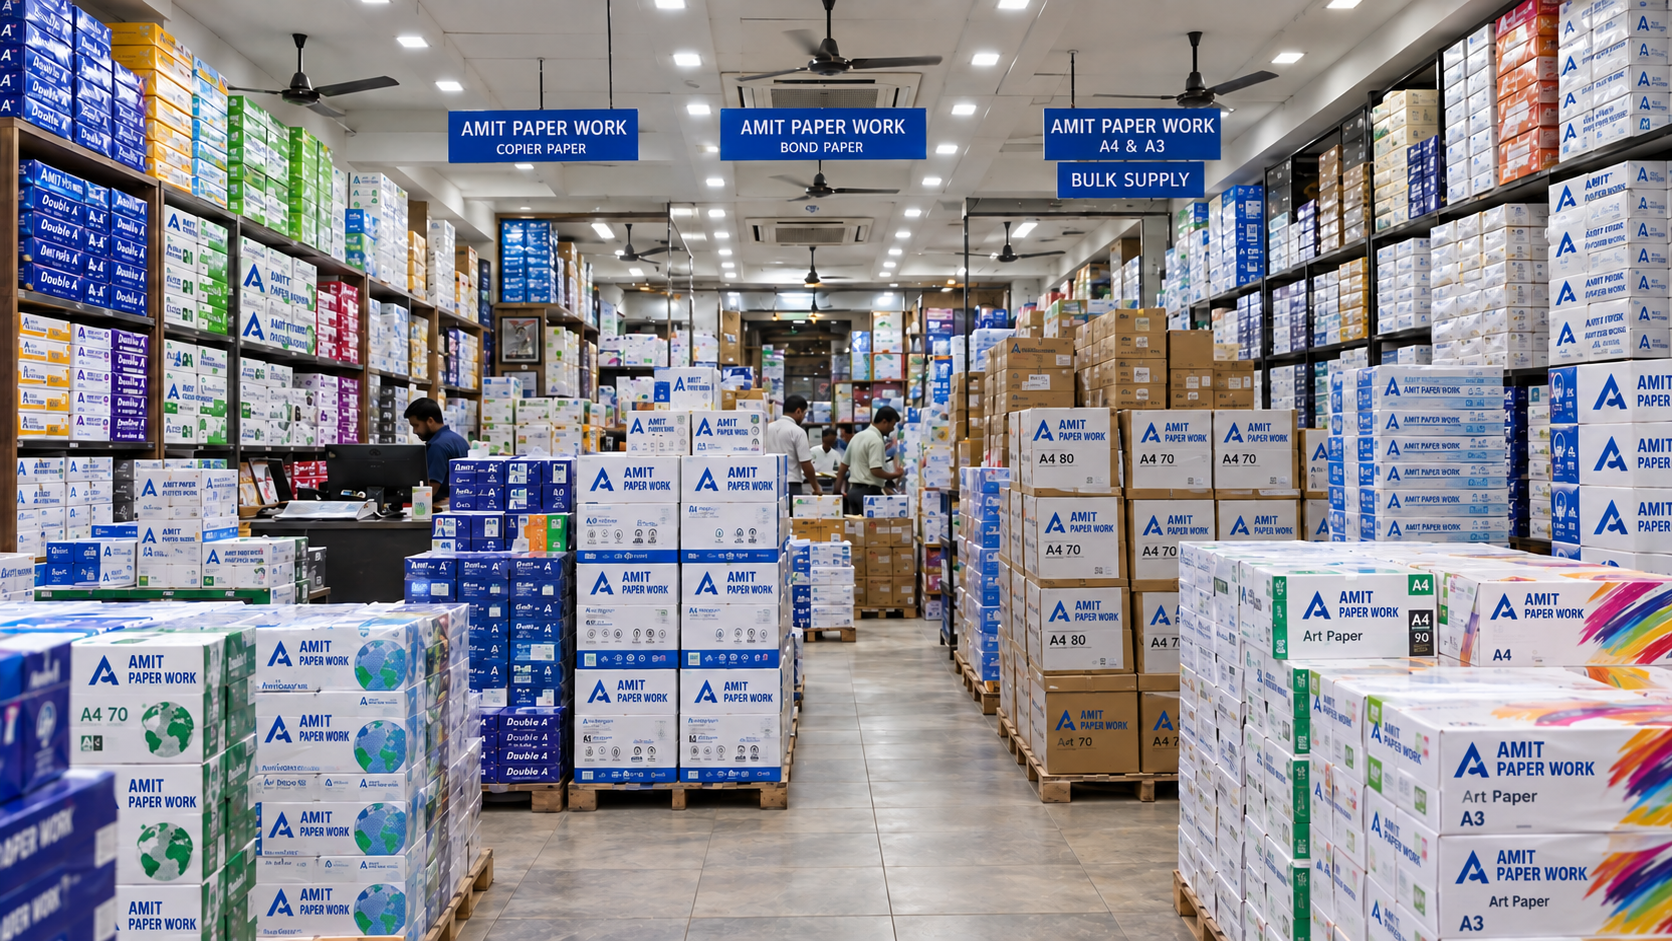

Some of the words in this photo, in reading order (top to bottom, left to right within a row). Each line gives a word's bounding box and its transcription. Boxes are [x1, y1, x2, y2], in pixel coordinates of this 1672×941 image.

[461, 120, 506, 137] AMIT
[513, 120, 568, 136] PAPER
[574, 120, 627, 136] WORK
[740, 119, 785, 135] AMIT
[791, 119, 846, 135] PAPER
[852, 118, 906, 135] WORK
[1050, 118, 1096, 134] AMIT
[1101, 118, 1156, 134] PAPER
[1162, 117, 1215, 134] WORK
[496, 144, 542, 155] COPIER
[547, 143, 586, 154] PAPER
[780, 142, 818, 153] BOND
[823, 141, 863, 153] PAPER
[1099, 140, 1119, 153] A4
[1125, 139, 1137, 153] &
[1145, 139, 1165, 153] A3
[1071, 172, 1117, 188] BULK
[1124, 172, 1190, 188] SUPPLY
[41, 218, 71, 238] Double
[41, 271, 70, 288] Double
[1637, 394, 1671, 408] PAPER
[1058, 419, 1086, 430] AMIT
[1164, 422, 1189, 432] AMIT
[1247, 423, 1272, 432] AMIT
[1058, 431, 1083, 441] PAPER
[1083, 431, 1106, 441] WORK
[1164, 434, 1186, 443] PAPER
[1187, 434, 1207, 443] WORK
[1247, 434, 1268, 443] PAPER
[1269, 434, 1288, 443] WORK
[1039, 453, 1056, 464] A4
[1059, 453, 1075, 464] 80
[1139, 453, 1157, 465] A4
[1160, 453, 1175, 465] 70
[1222, 453, 1239, 465] A4
[1242, 453, 1257, 465] 70
[1637, 456, 1671, 469] PAPER
[624, 466, 655, 479] AMIT
[727, 466, 758, 479] AMIT
[623, 480, 648, 491] PAPER
[648, 480, 671, 491] WORK
[727, 480, 750, 491] PAPER
[751, 480, 774, 491] WORK
[1070, 511, 1098, 523] AMIT
[1167, 514, 1194, 525] AMIT
[1254, 515, 1278, 525] AMIT
[1070, 524, 1092, 533] PAPER
[1093, 524, 1114, 533] WORK
[1638, 520, 1672, 532] PAPER
[1045, 544, 1063, 555] A4
[1066, 544, 1081, 555] 70
[1142, 546, 1159, 557] A4
[1162, 546, 1177, 557] 70
[622, 571, 651, 583] AMIT
[727, 571, 757, 583] AMIT
[622, 585, 645, 594] PAPER
[646, 585, 669, 594] WORK
[727, 585, 750, 595] PAPER
[750, 585, 773, 595] WORK
[1412, 579, 1430, 591] A4
[1339, 590, 1374, 604] AMIT
[1524, 592, 1560, 606] AMIT
[1075, 600, 1102, 611] AMIT
[1075, 612, 1097, 622] PAPER
[1097, 612, 1119, 622] WORK
[1339, 606, 1369, 618] PAPER
[1370, 606, 1399, 618] WORK
[1524, 608, 1554, 619] PAPER
[1555, 608, 1585, 619] WORK
[1411, 613, 1430, 626] A4
[1049, 634, 1067, 646] A4
[1071, 634, 1086, 646] 80
[1151, 637, 1167, 648] A4
[1302, 630, 1323, 642] Art
[1326, 630, 1363, 644] Paper
[1414, 632, 1429, 643] 90
[299, 640, 332, 653] AMIT
[1492, 648, 1512, 661] A4
[128, 654, 164, 669] AMIT
[299, 656, 324, 666] PAPER
[325, 656, 350, 666] WORK
[128, 672, 162, 684] PAPER
[164, 672, 197, 684] WORK
[617, 679, 646, 691] AMIT
[724, 681, 749, 691] AMIT
[617, 693, 642, 703] PAPER
[643, 693, 668, 703] WORK
[724, 693, 748, 703] PAPER
[749, 693, 773, 703] WORK
[80, 706, 103, 722] A4
[108, 706, 128, 722] 70
[1080, 710, 1104, 720] AMIT
[299, 714, 332, 728] AMIT
[506, 717, 539, 727] Double
[541, 718, 548, 727] A
[1080, 721, 1104, 730] PAPER
[1105, 721, 1128, 730] WORK
[299, 730, 324, 742] PAPER
[325, 730, 350, 742] WORK
[506, 733, 539, 742] Double
[1078, 737, 1093, 746] 70
[1152, 736, 1169, 747] A4
[1496, 741, 1545, 758] AMIT
[541, 752, 548, 760] A
[506, 767, 539, 776] Double
[541, 767, 548, 776] A
[1496, 761, 1545, 776] PAPER
[1549, 761, 1595, 776] WORK
[128, 778, 164, 793] AMIT
[128, 796, 162, 808] PAPER
[164, 796, 197, 808] WORK
[1461, 790, 1487, 804] Art
[1492, 790, 1538, 806] Paper
[300, 811, 333, 824] AMIT
[1460, 810, 1485, 827] A3
[300, 826, 324, 837] PAPER
[326, 826, 350, 837] WORK
[1496, 849, 1536, 865] AMIT
[1496, 866, 1541, 881] PAPER
[1544, 866, 1588, 881] WORK
[300, 888, 333, 901] AMIT
[128, 901, 163, 915] AMIT
[1488, 895, 1509, 908] Art
[1512, 895, 1550, 910] Paper
[300, 904, 325, 915] PAPER
[326, 904, 350, 915] WORK
[128, 918, 162, 931] PAPER
[164, 918, 197, 931] WORK
[1459, 915, 1484, 932] A3
